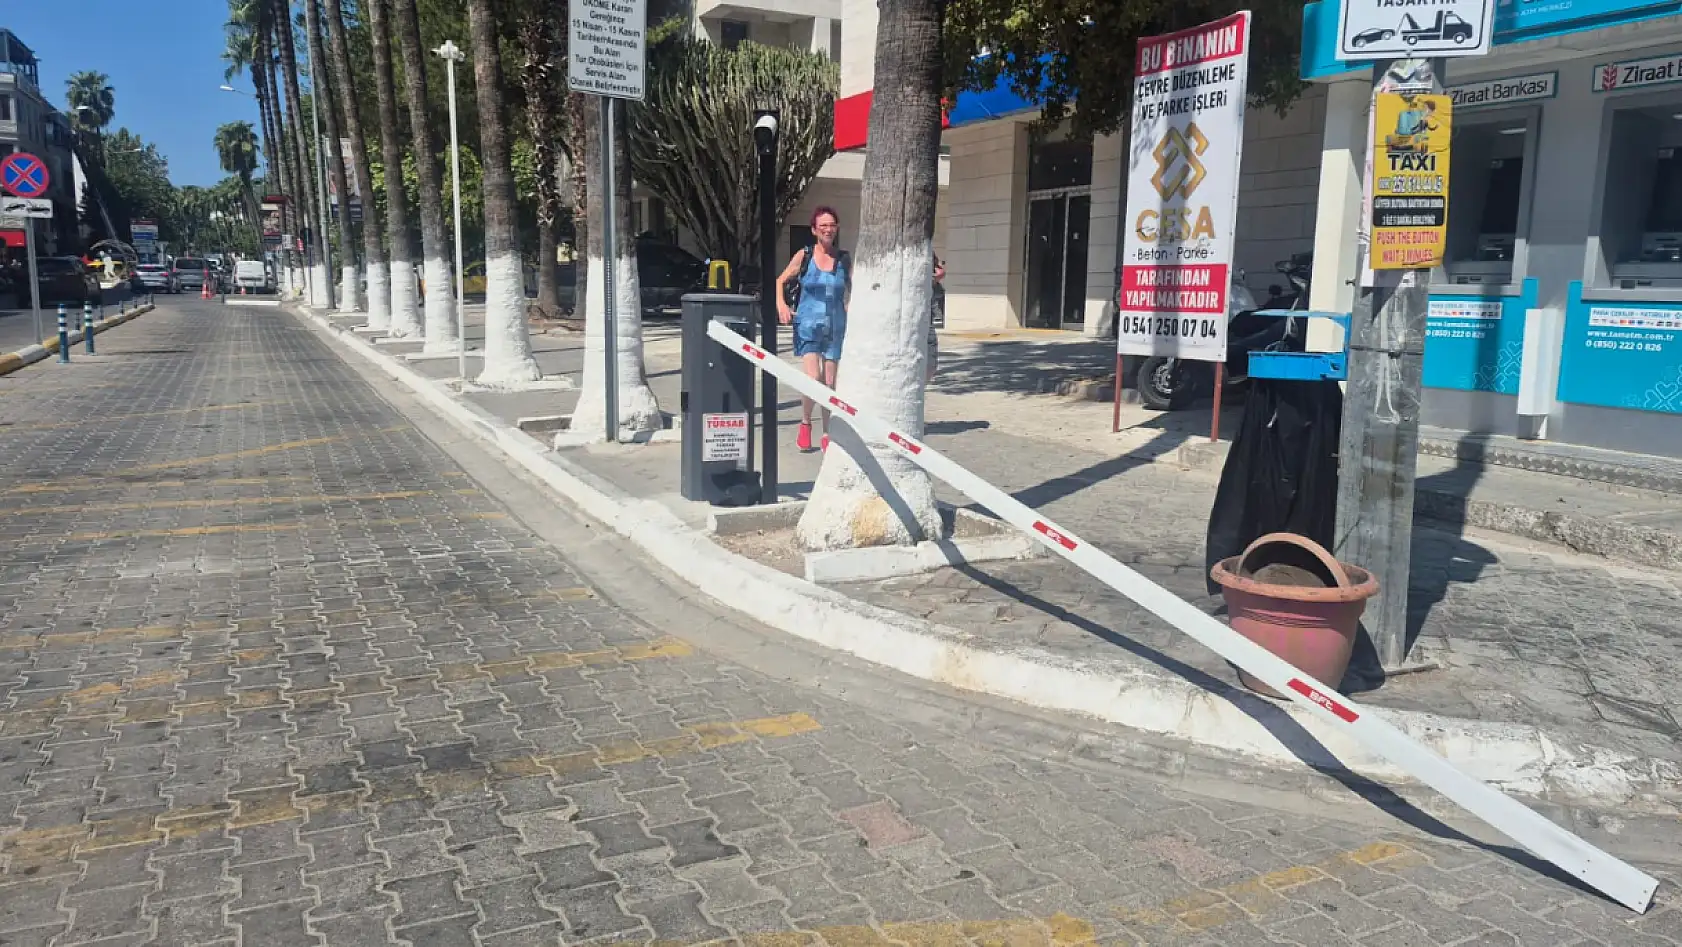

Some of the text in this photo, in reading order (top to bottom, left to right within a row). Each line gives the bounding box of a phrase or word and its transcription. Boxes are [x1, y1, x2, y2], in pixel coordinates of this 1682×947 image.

[590, 10, 625, 24] Gereğince
[572, 19, 580, 28] 15
[583, 20, 602, 32] Nisan
[609, 25, 616, 34] 15
[619, 27, 640, 38] Kasım
[576, 54, 586, 63] Tur
[594, 45, 620, 58] Bu Alan
[1141, 44, 1161, 73] BU
[585, 67, 606, 78] Servis
[1622, 61, 1675, 84] Ziraat
[571, 76, 593, 88] Olarak
[1138, 63, 1235, 102] ÇEVRE DÜZENLEME
[1452, 86, 1490, 105] Ziraat
[1493, 79, 1548, 99] Bankası
[1141, 103, 1154, 120] VE
[1157, 97, 1190, 117] PARKE
[1388, 154, 1436, 171] TAXI
[1135, 206, 1216, 242] CESA
[1377, 231, 1439, 244] PUSH THE BUTTON
[1137, 248, 1168, 261] Beton
[1176, 247, 1208, 260] Parke
[1382, 249, 1400, 262] WAIT
[1136, 269, 1211, 287] TARAFINDAN
[1126, 290, 1219, 309] YAPILMAKTADIR
[1123, 316, 1217, 339] 0 541 250 07 04
[1585, 339, 1592, 347] 0
[1619, 341, 1636, 350] 222
[1636, 341, 1643, 350] 0
[1645, 343, 1662, 352] 826
